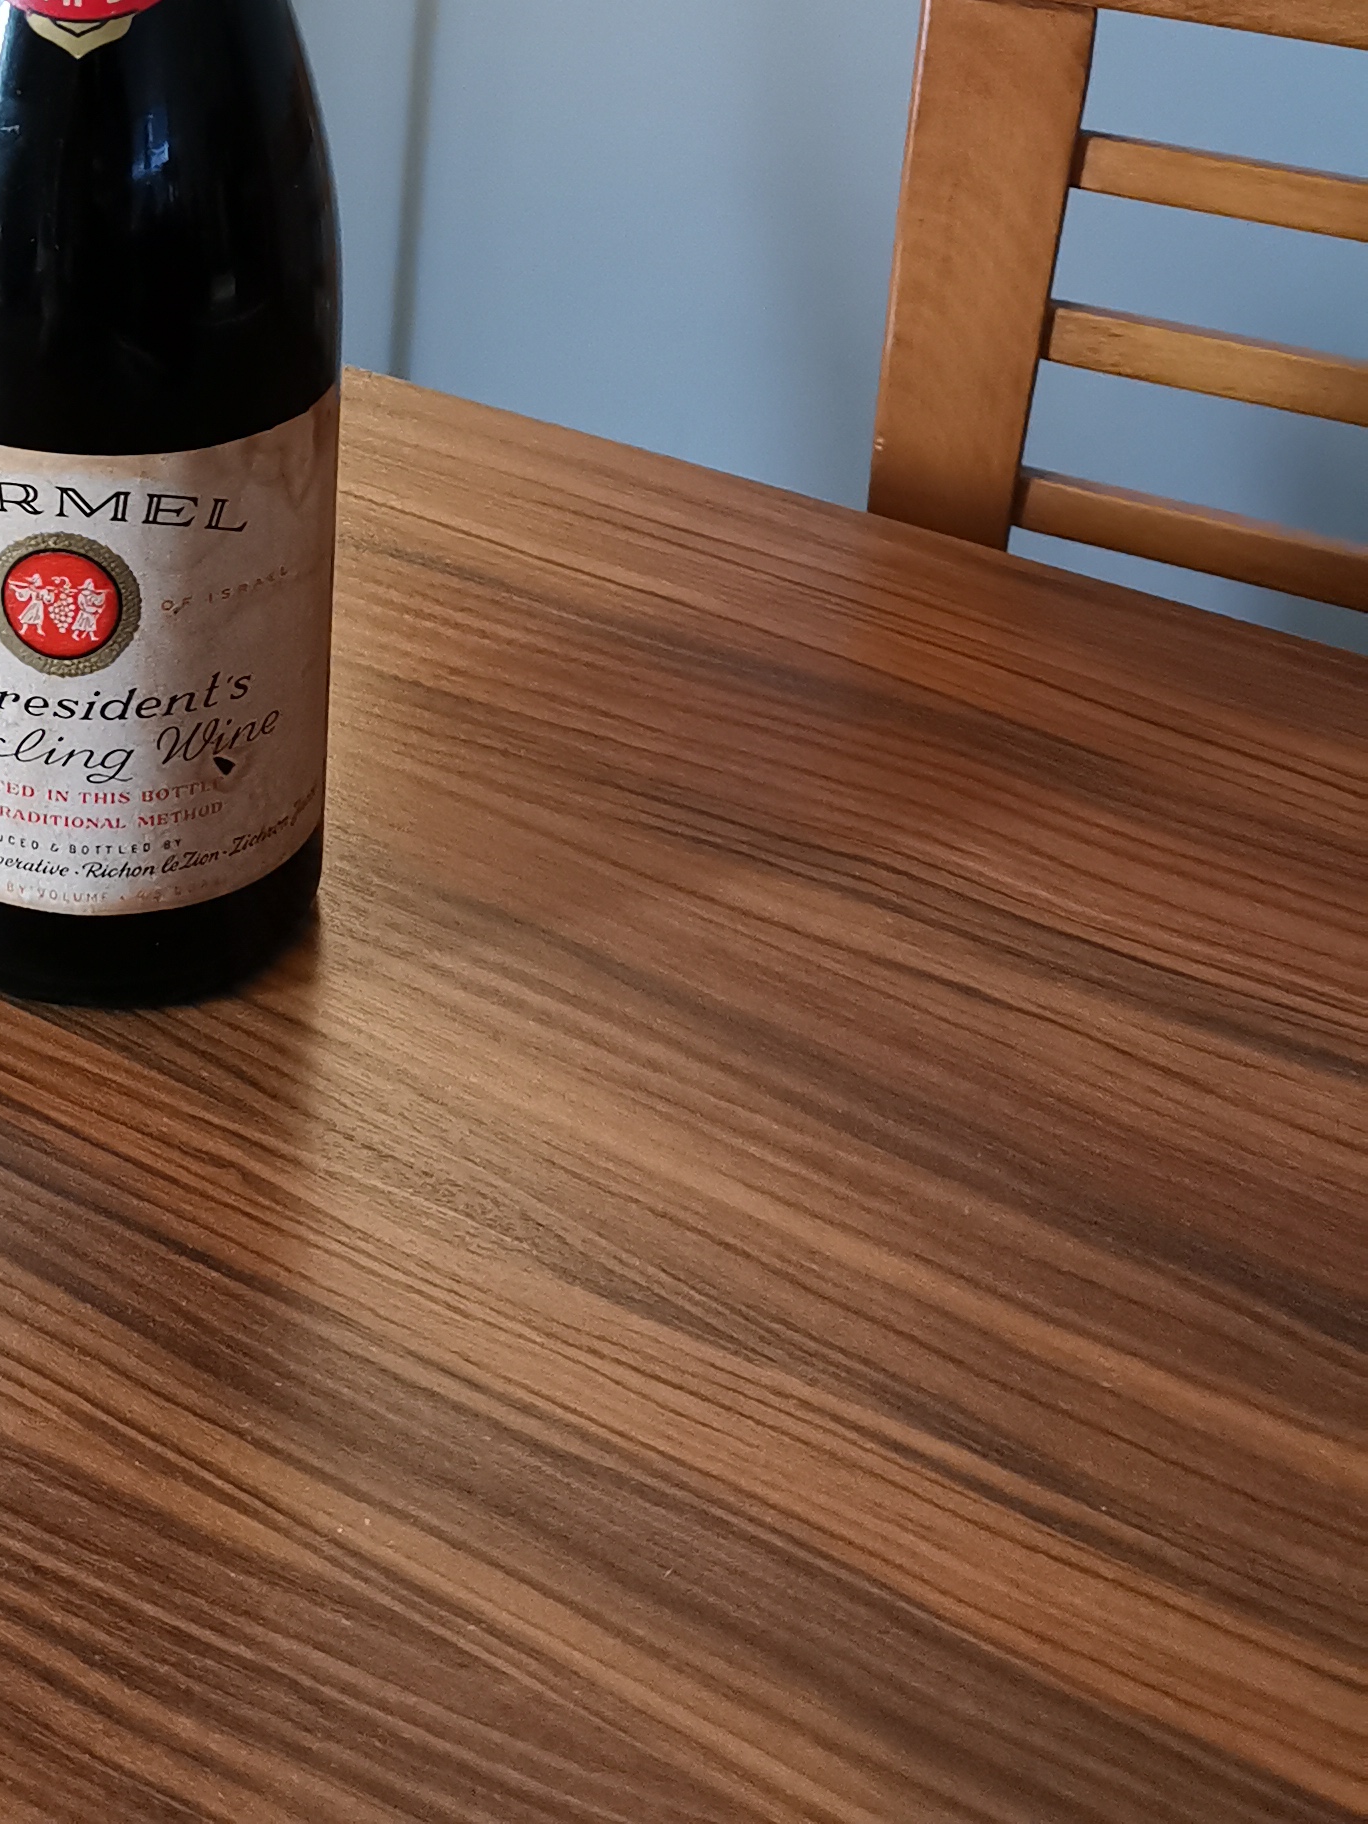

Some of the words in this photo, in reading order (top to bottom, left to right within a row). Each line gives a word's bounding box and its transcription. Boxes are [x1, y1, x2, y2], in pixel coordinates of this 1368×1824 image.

[156, 709, 280, 765] Wine
[47, 788, 70, 804] IN
[77, 790, 132, 806] THIS
[137, 800, 224, 828] METHOD
[68, 841, 151, 856] BOTTLED
[163, 838, 183, 851] BY
[81, 860, 156, 879] Richon
